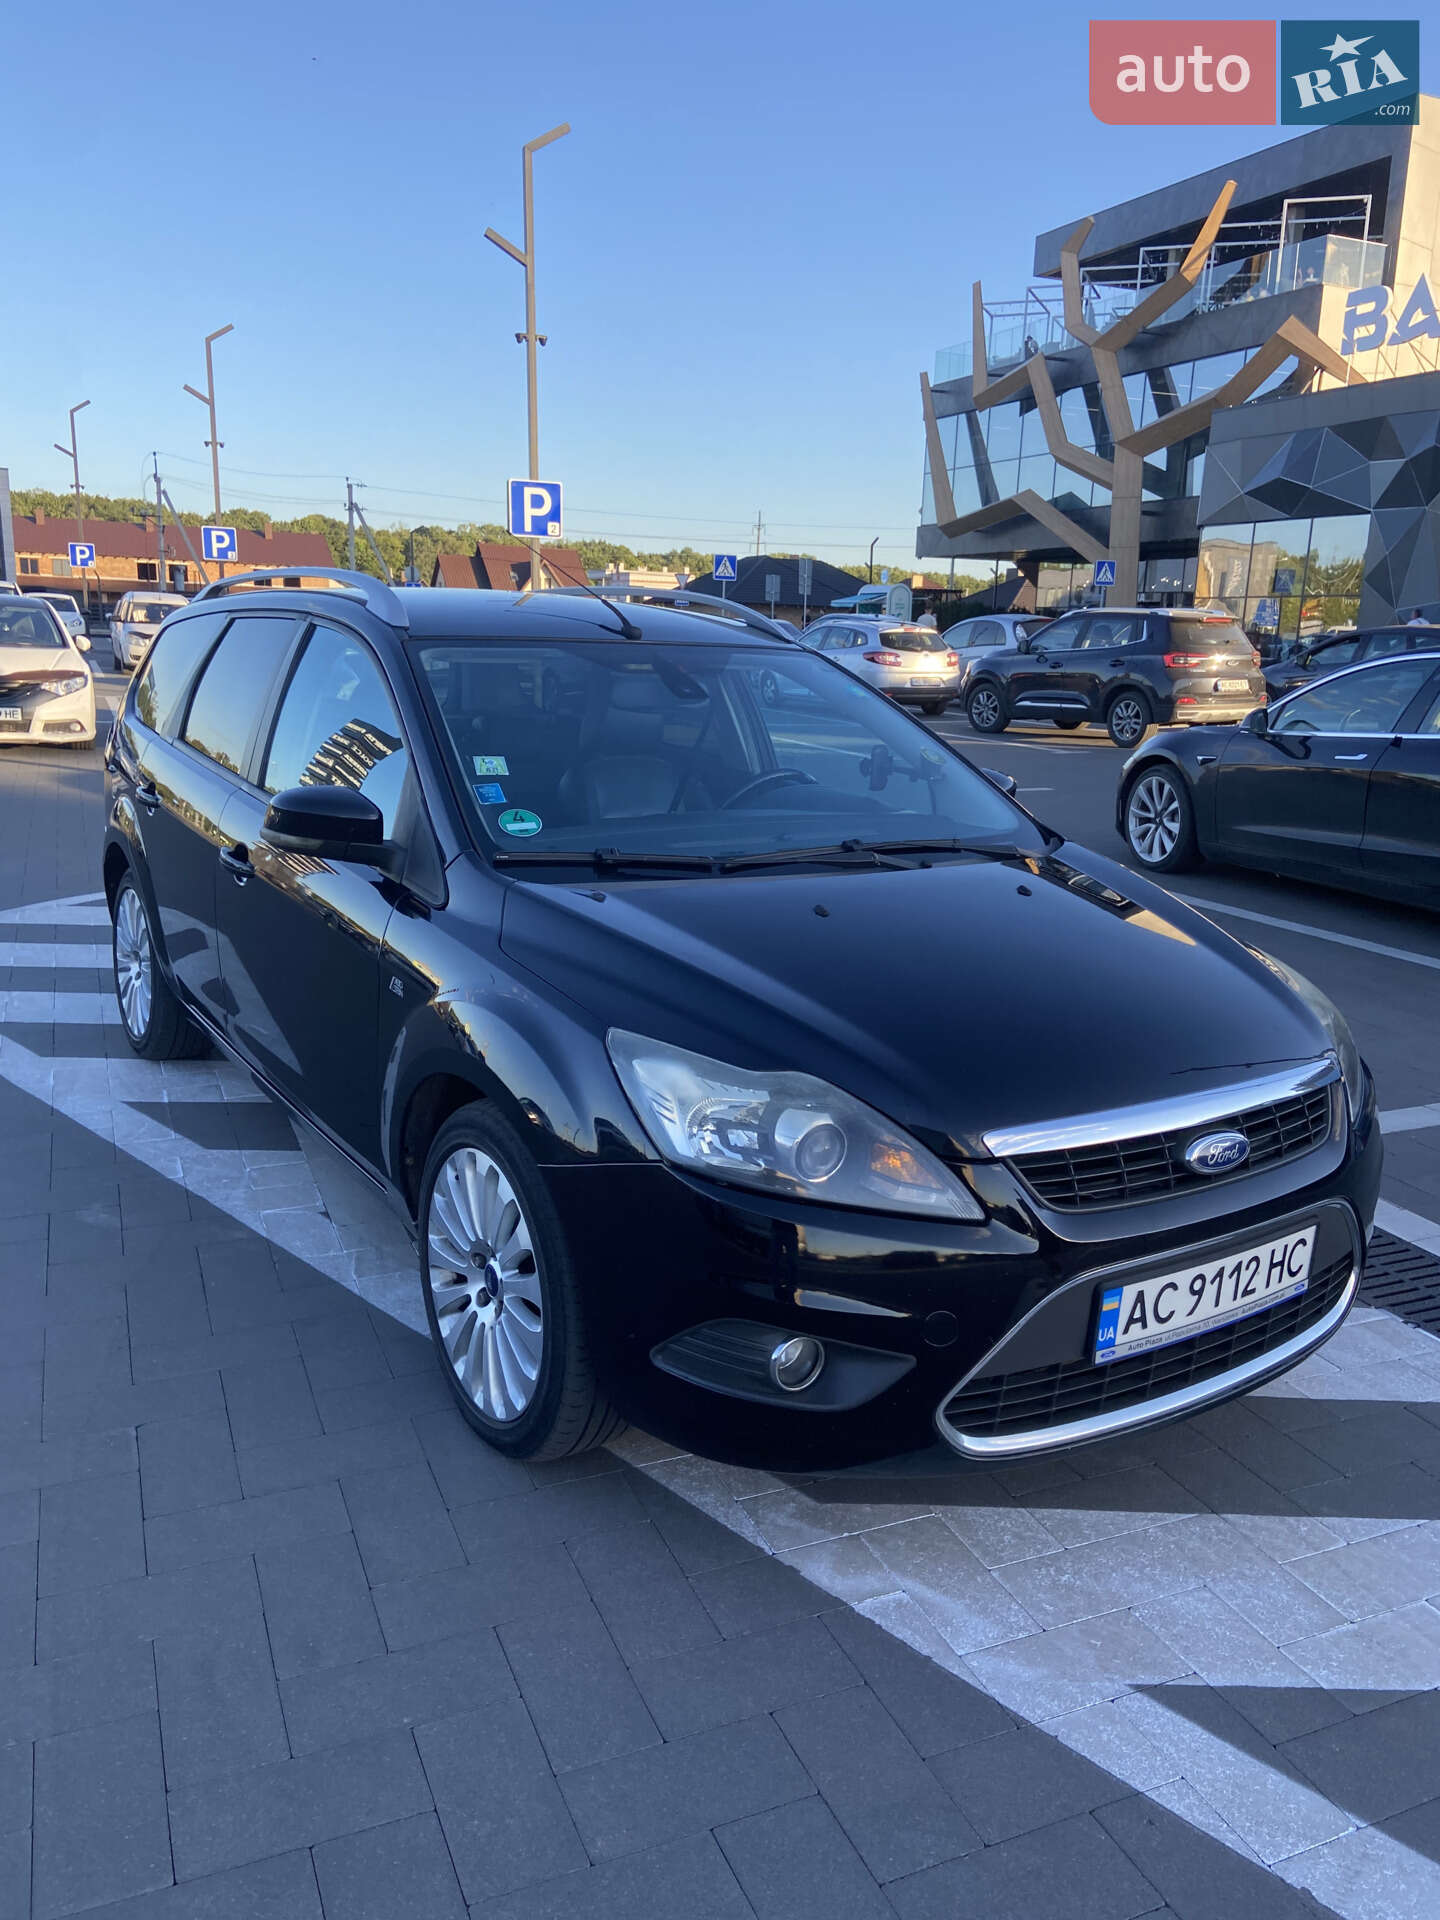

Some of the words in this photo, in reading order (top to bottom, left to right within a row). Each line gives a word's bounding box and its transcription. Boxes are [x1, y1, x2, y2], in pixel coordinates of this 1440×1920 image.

[523, 486, 552, 533] P
[75, 546, 90, 565] P
[211, 530, 230, 558] P
[513, 811, 525, 823] 4
[1207, 1141, 1240, 1166] Ford
[1122, 1281, 1179, 1335] AC
[1186, 1254, 1261, 1317] 9112
[1265, 1237, 1307, 1289] HC
[1098, 1326, 1115, 1342] UA
